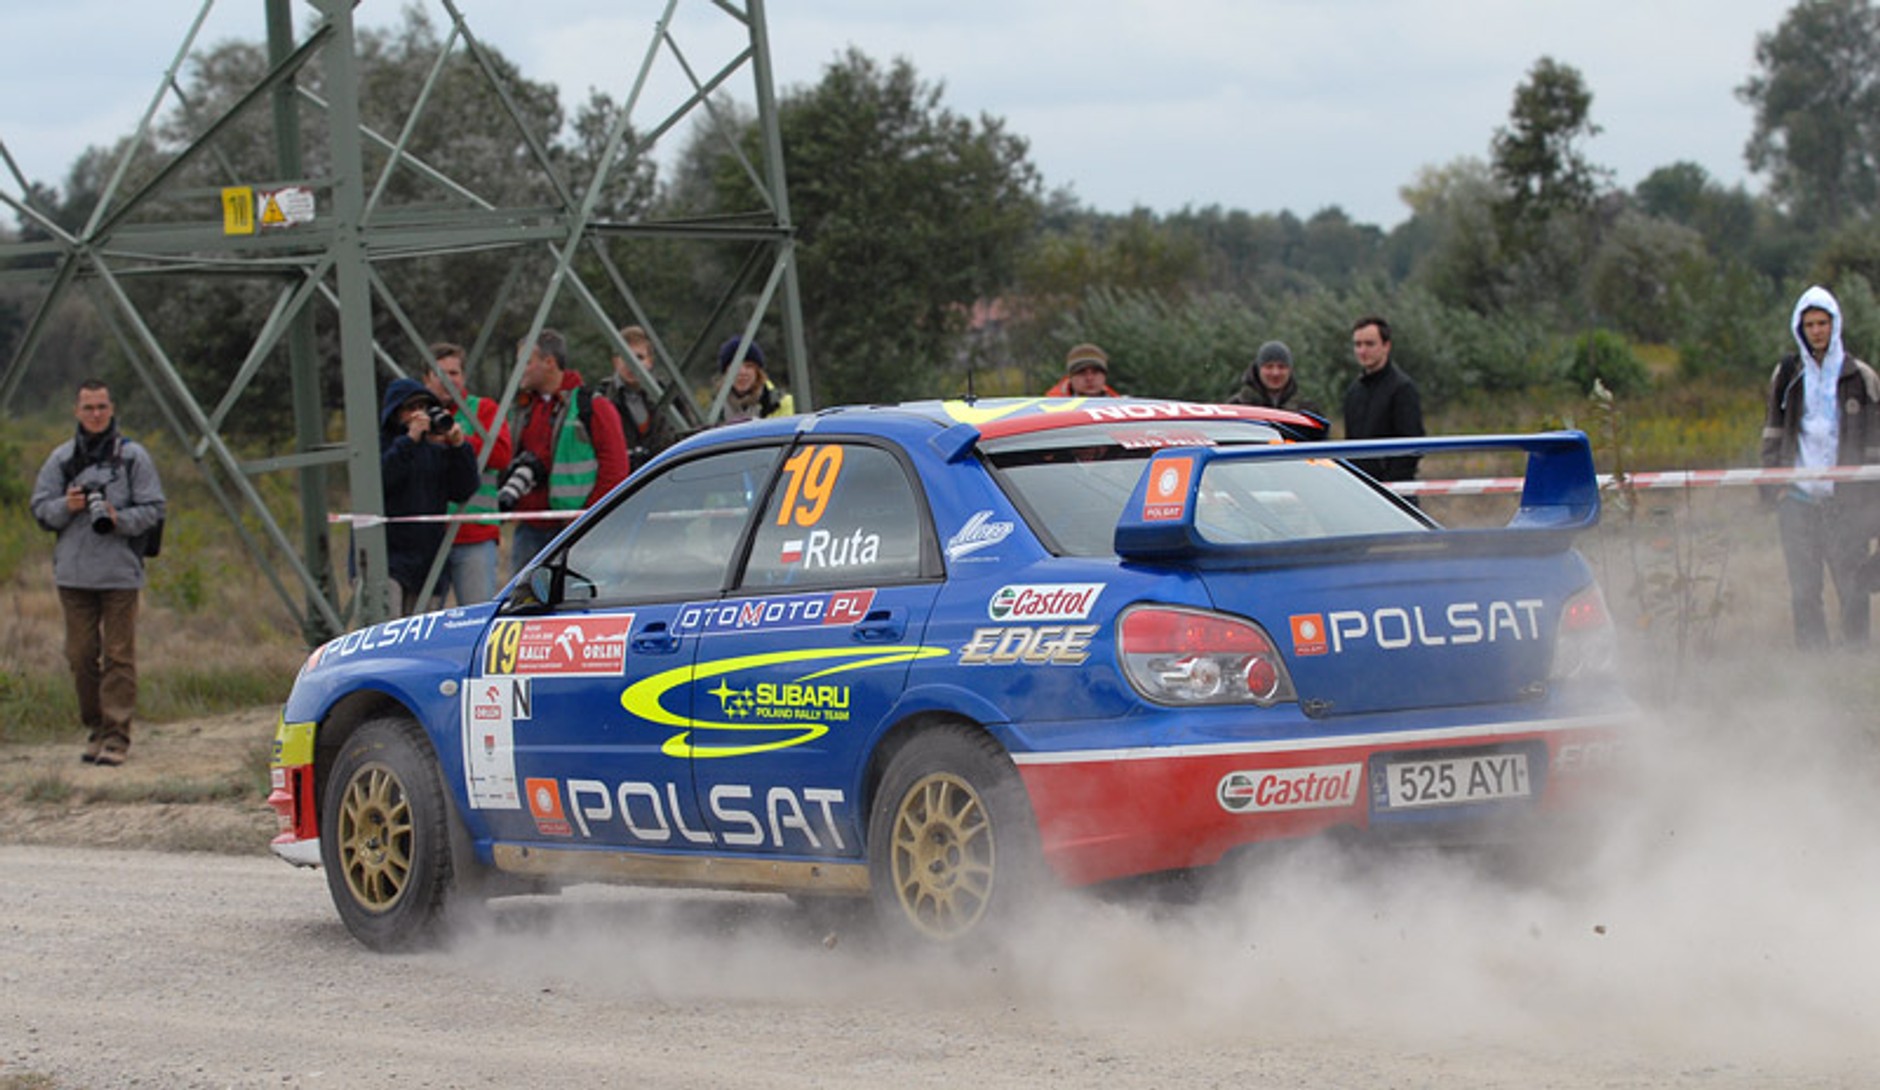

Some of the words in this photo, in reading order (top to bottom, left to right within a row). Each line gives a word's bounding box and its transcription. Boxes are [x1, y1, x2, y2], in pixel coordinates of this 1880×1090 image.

[1084, 402, 1238, 420] NOVOL
[777, 445, 843, 527] 19
[804, 527, 880, 569] Ruta
[1013, 587, 1094, 616] Castrol
[320, 610, 446, 666] POLSAT
[958, 624, 1101, 666] EDGE
[1329, 600, 1543, 653] POLSAT
[487, 620, 524, 674] 19
[519, 645, 554, 660] RALLY
[583, 643, 622, 659] ORLEN
[512, 680, 530, 717] N
[756, 683, 849, 708] SUBARU
[756, 706, 792, 719] POLAND
[794, 708, 821, 719] RALLY
[824, 710, 849, 720] TEAM
[1255, 770, 1352, 807] Castrol
[1400, 764, 1456, 801] 525
[1467, 757, 1520, 796] AYI
[567, 779, 845, 849] POLSAT
